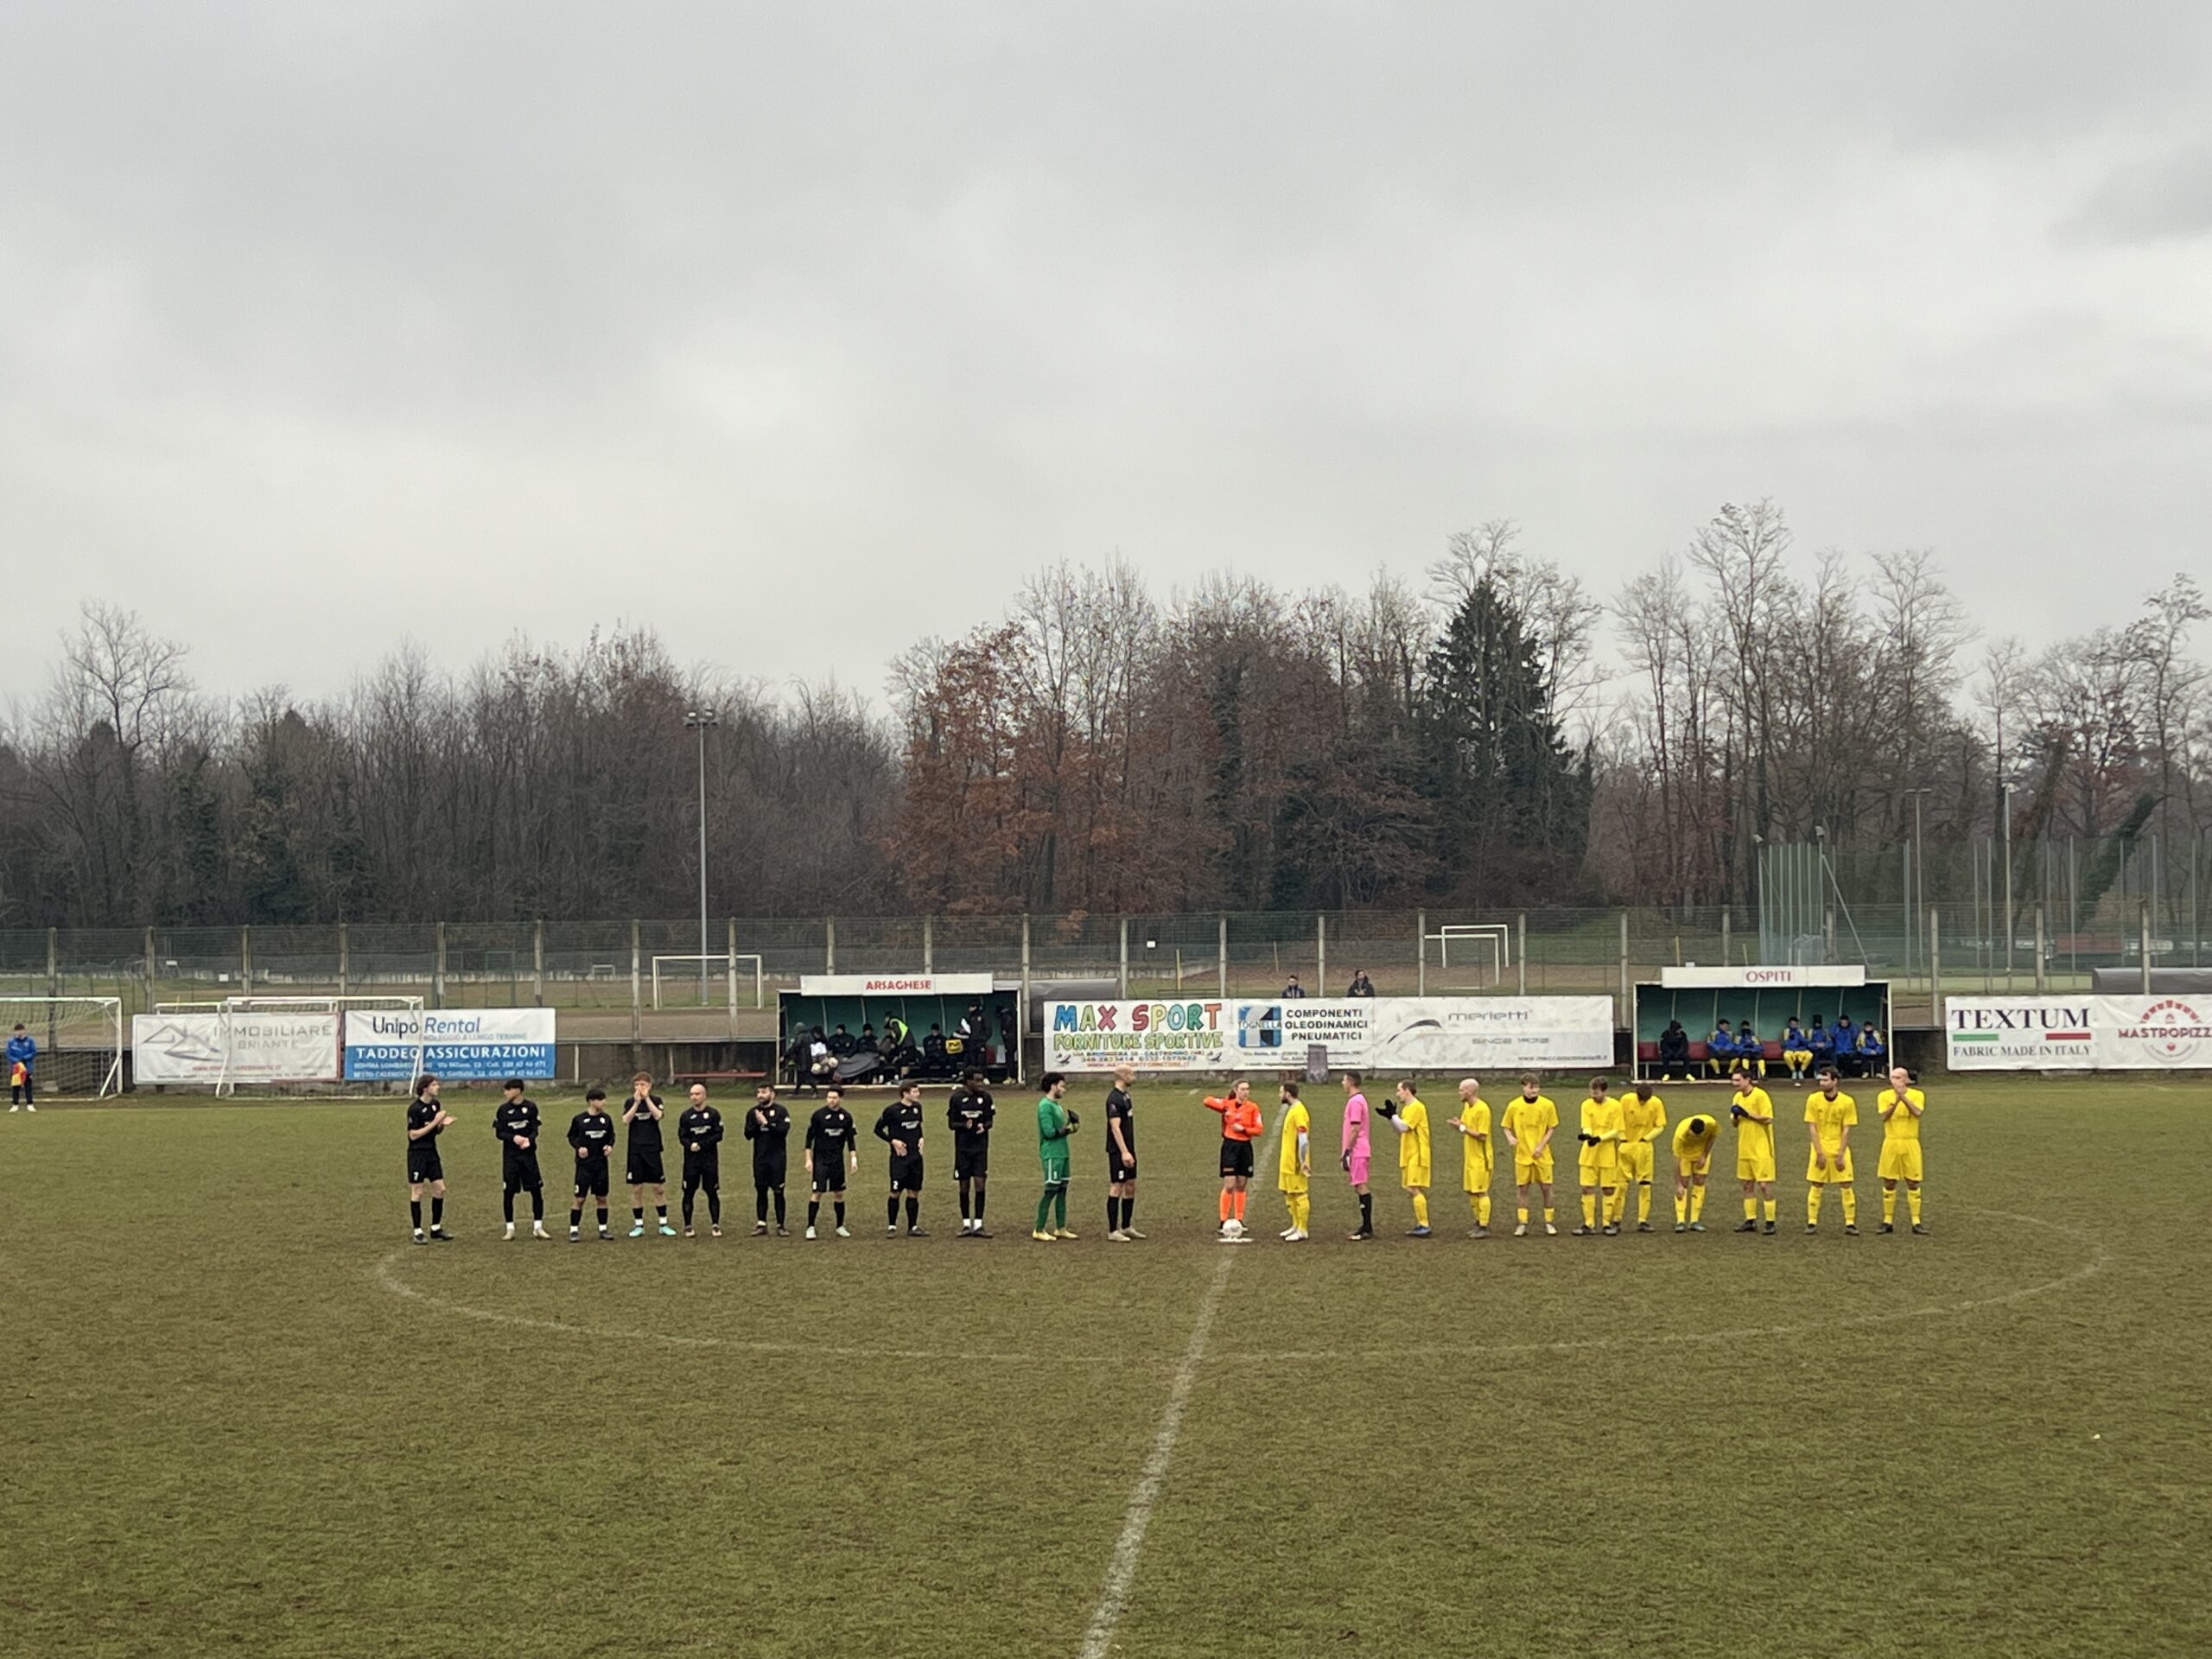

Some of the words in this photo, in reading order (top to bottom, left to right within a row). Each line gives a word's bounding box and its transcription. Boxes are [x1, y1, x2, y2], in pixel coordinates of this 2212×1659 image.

[1745, 970, 1791, 982] OSPITI
[866, 980, 931, 990] ARSAGHESE
[1053, 1004, 1117, 1032] MAX
[1132, 1003, 1223, 1032] SPORT
[1286, 1009, 1363, 1018] COMPONENTI
[1951, 1008, 2090, 1029] TEXTUM
[372, 1016, 419, 1039] Unipo
[424, 1016, 481, 1033] Rental
[1238, 1020, 1281, 1030] TOGNELLA
[1285, 1020, 1368, 1030] OLEODINAMICI
[1053, 1032, 1142, 1052] FORNITURE
[1144, 1031, 1224, 1049] SPORTIVE
[1291, 1032, 1362, 1040] PNEUMATICI
[426, 1046, 546, 1059] ASSICURAZIONI
[1953, 1046, 1998, 1057] FABRIC
[2001, 1046, 2037, 1056] MADE
[2039, 1046, 2052, 1055] IN
[2055, 1045, 2092, 1055] ITALY
[413, 1171, 419, 1180] 7
[893, 1180, 899, 1189] 2
